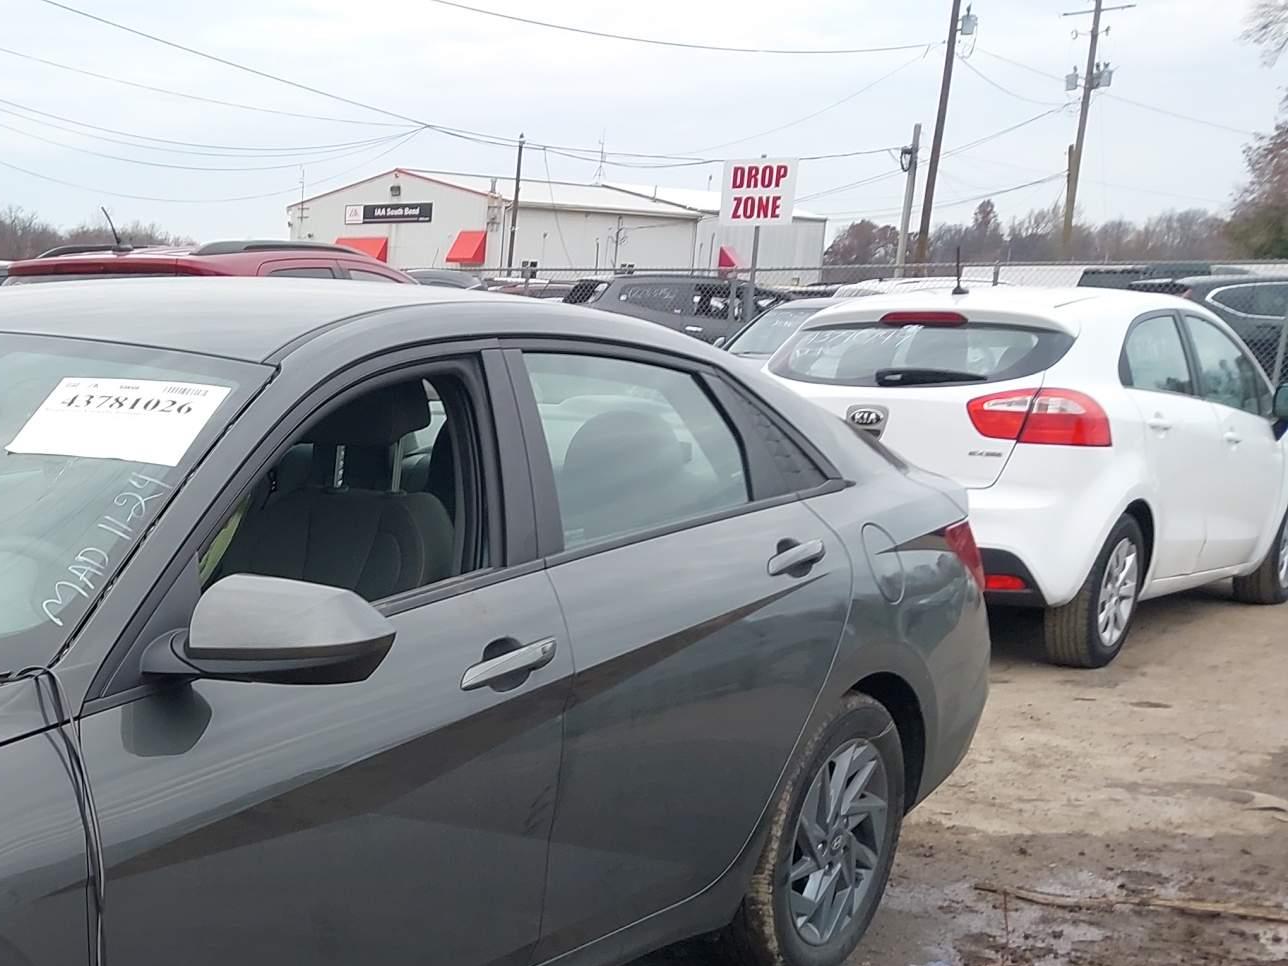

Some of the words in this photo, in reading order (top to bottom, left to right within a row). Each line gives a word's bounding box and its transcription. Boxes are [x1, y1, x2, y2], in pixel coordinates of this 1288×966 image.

[732, 164, 788, 189] DROP
[374, 207, 386, 216] IAA
[386, 206, 403, 216] South
[404, 206, 420, 216] Bend
[731, 195, 781, 219] ZONE
[61, 394, 193, 415] 43781026
[854, 411, 878, 424] KIA
[42, 547, 109, 627] MAD
[97, 471, 174, 541] 11-24
